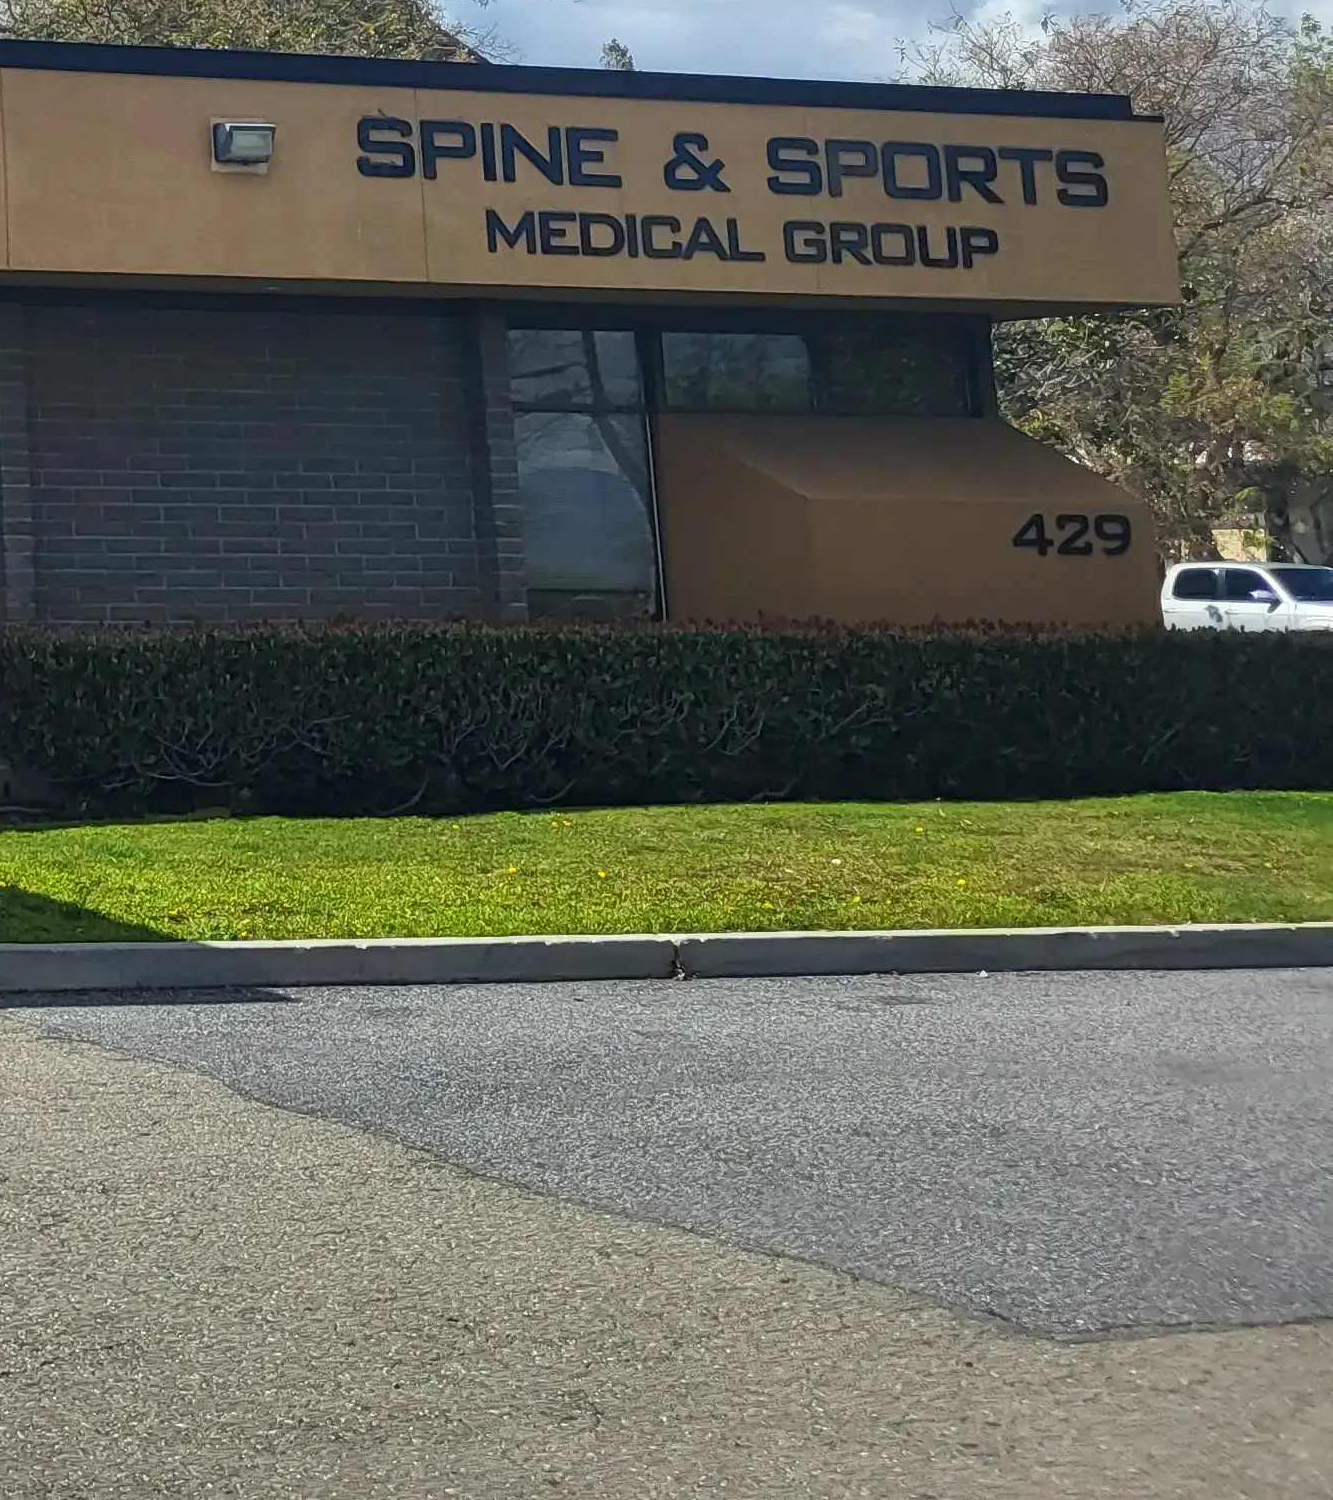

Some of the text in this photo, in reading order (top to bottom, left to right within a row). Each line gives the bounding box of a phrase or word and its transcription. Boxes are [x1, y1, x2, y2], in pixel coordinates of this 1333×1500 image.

[356, 115, 1109, 207] SPINE & SPORTS
[485, 208, 1000, 269] MEDICAL GROUP
[1011, 513, 1132, 557] 429
